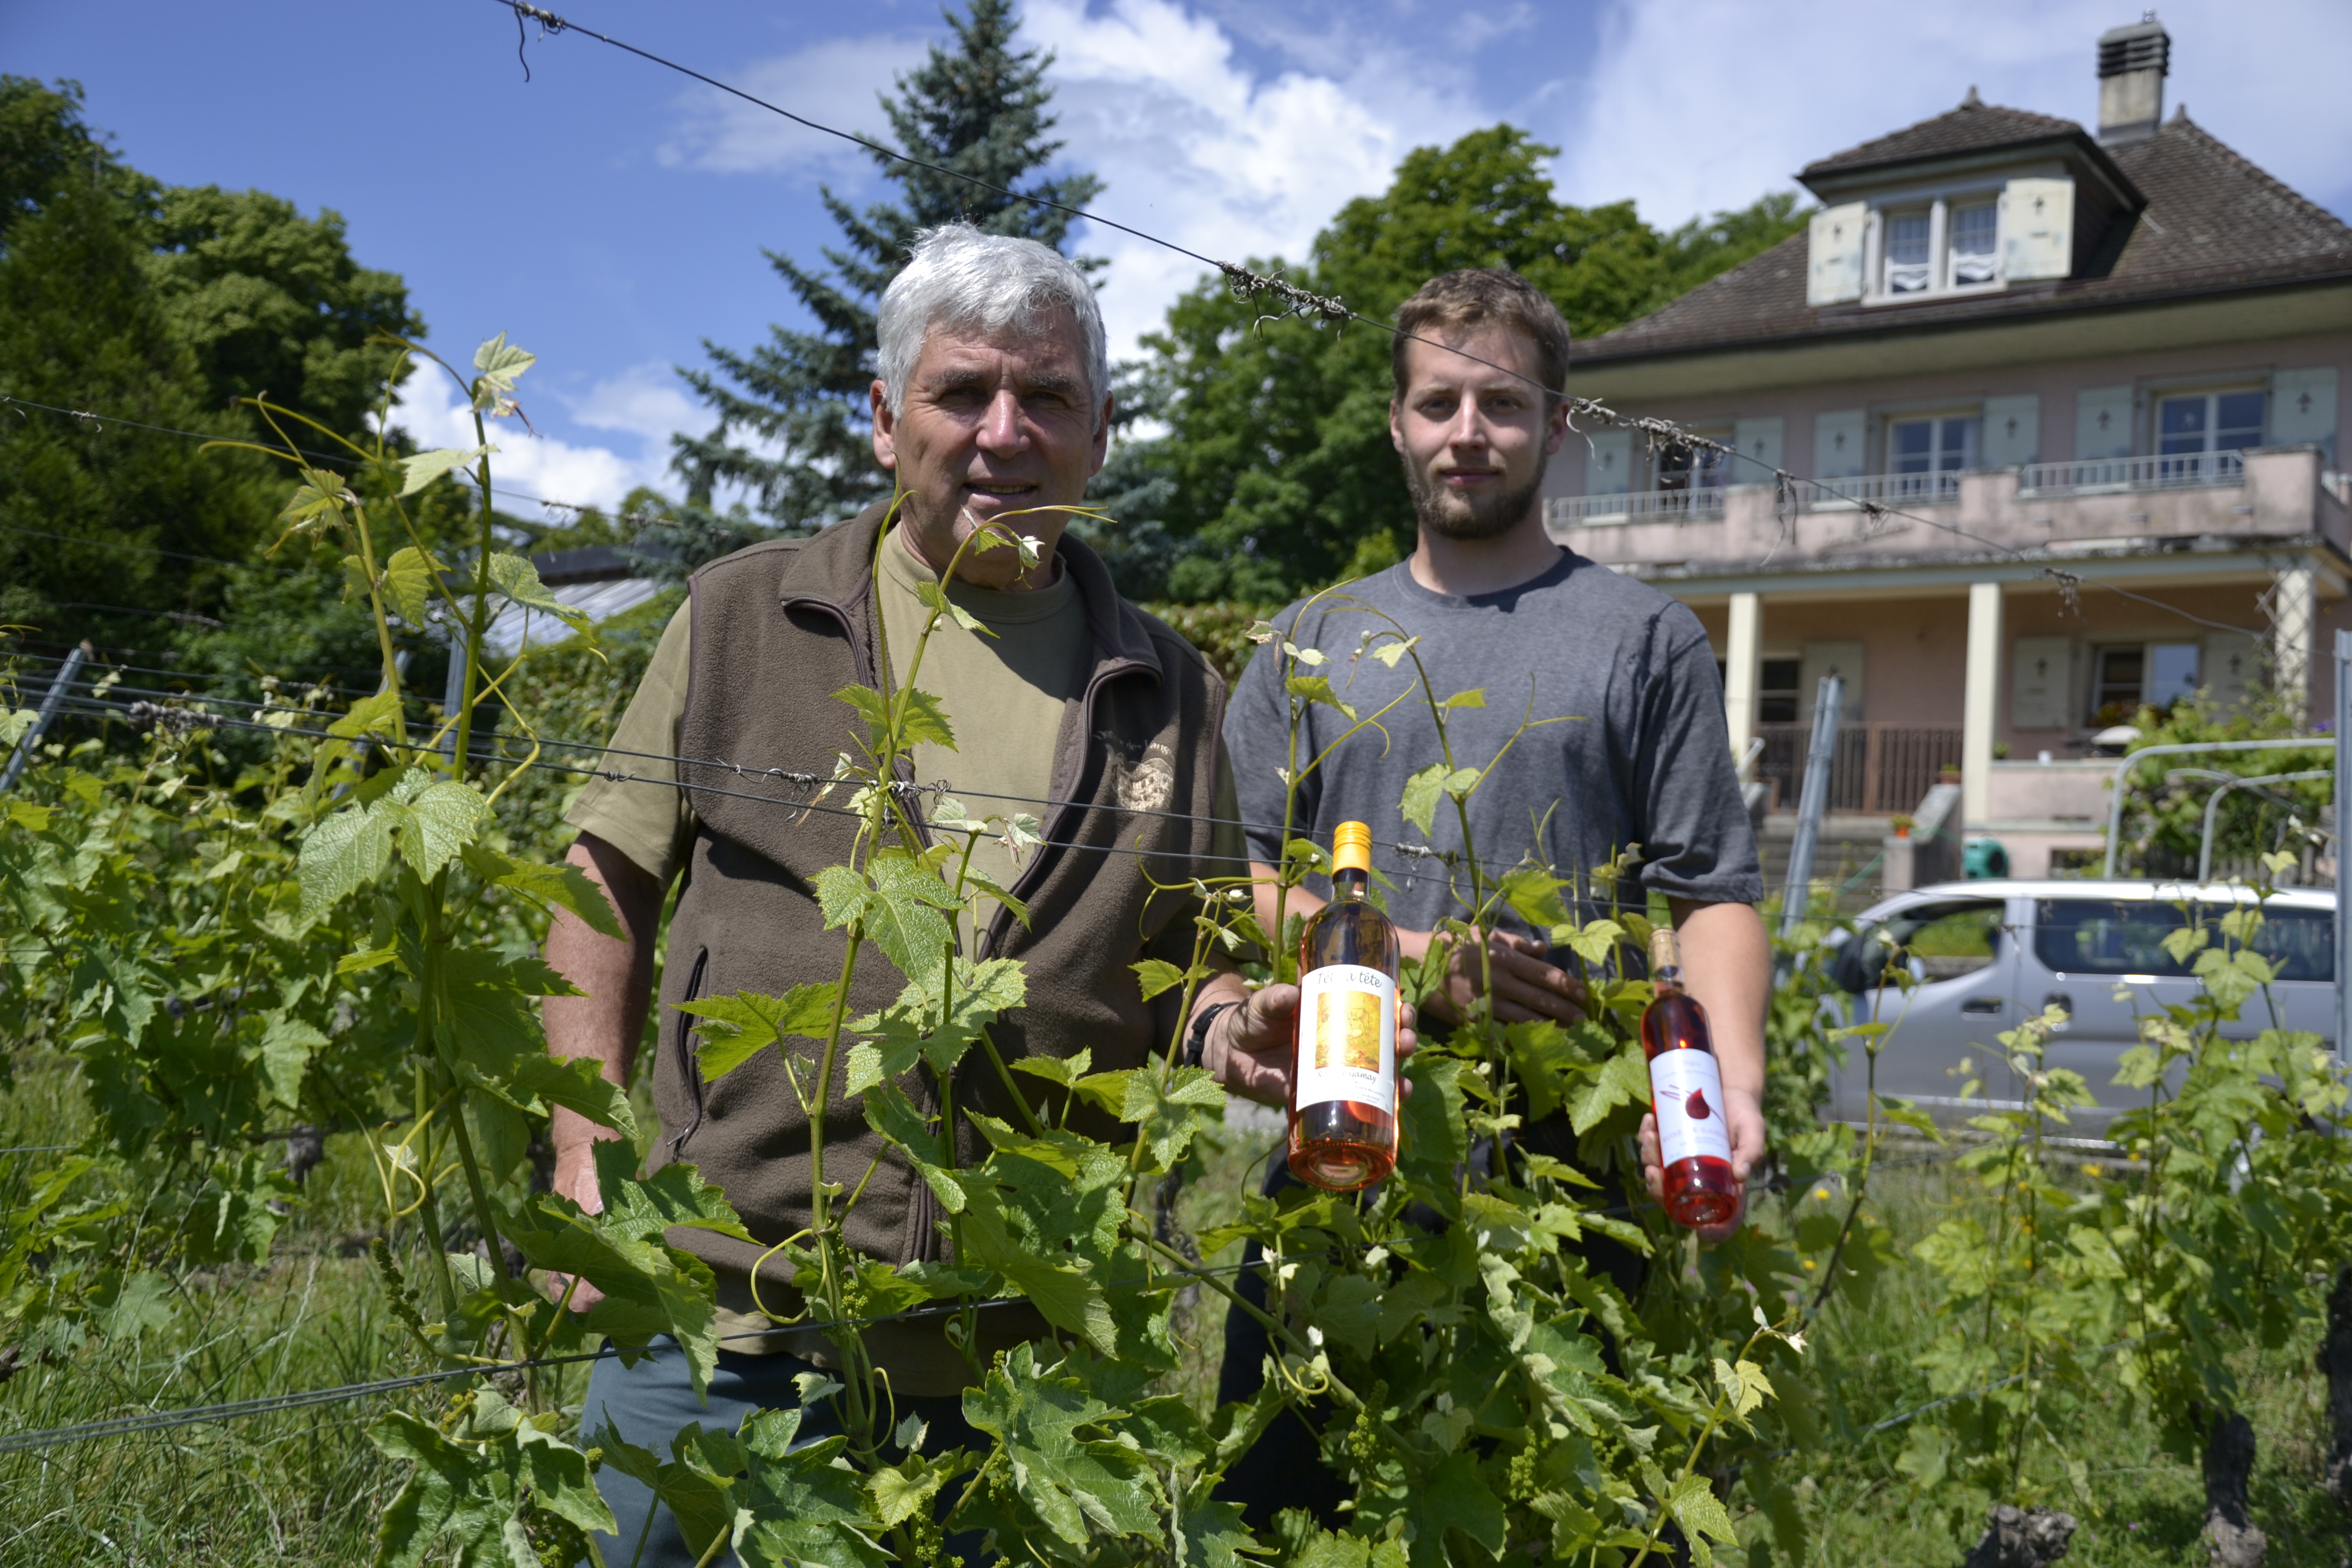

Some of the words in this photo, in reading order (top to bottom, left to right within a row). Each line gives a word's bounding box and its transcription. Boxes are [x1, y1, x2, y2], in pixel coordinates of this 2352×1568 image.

[1317, 970, 1335, 985] Têt
[1359, 971, 1383, 988] tête
[1349, 1069, 1377, 1084] Gamay
